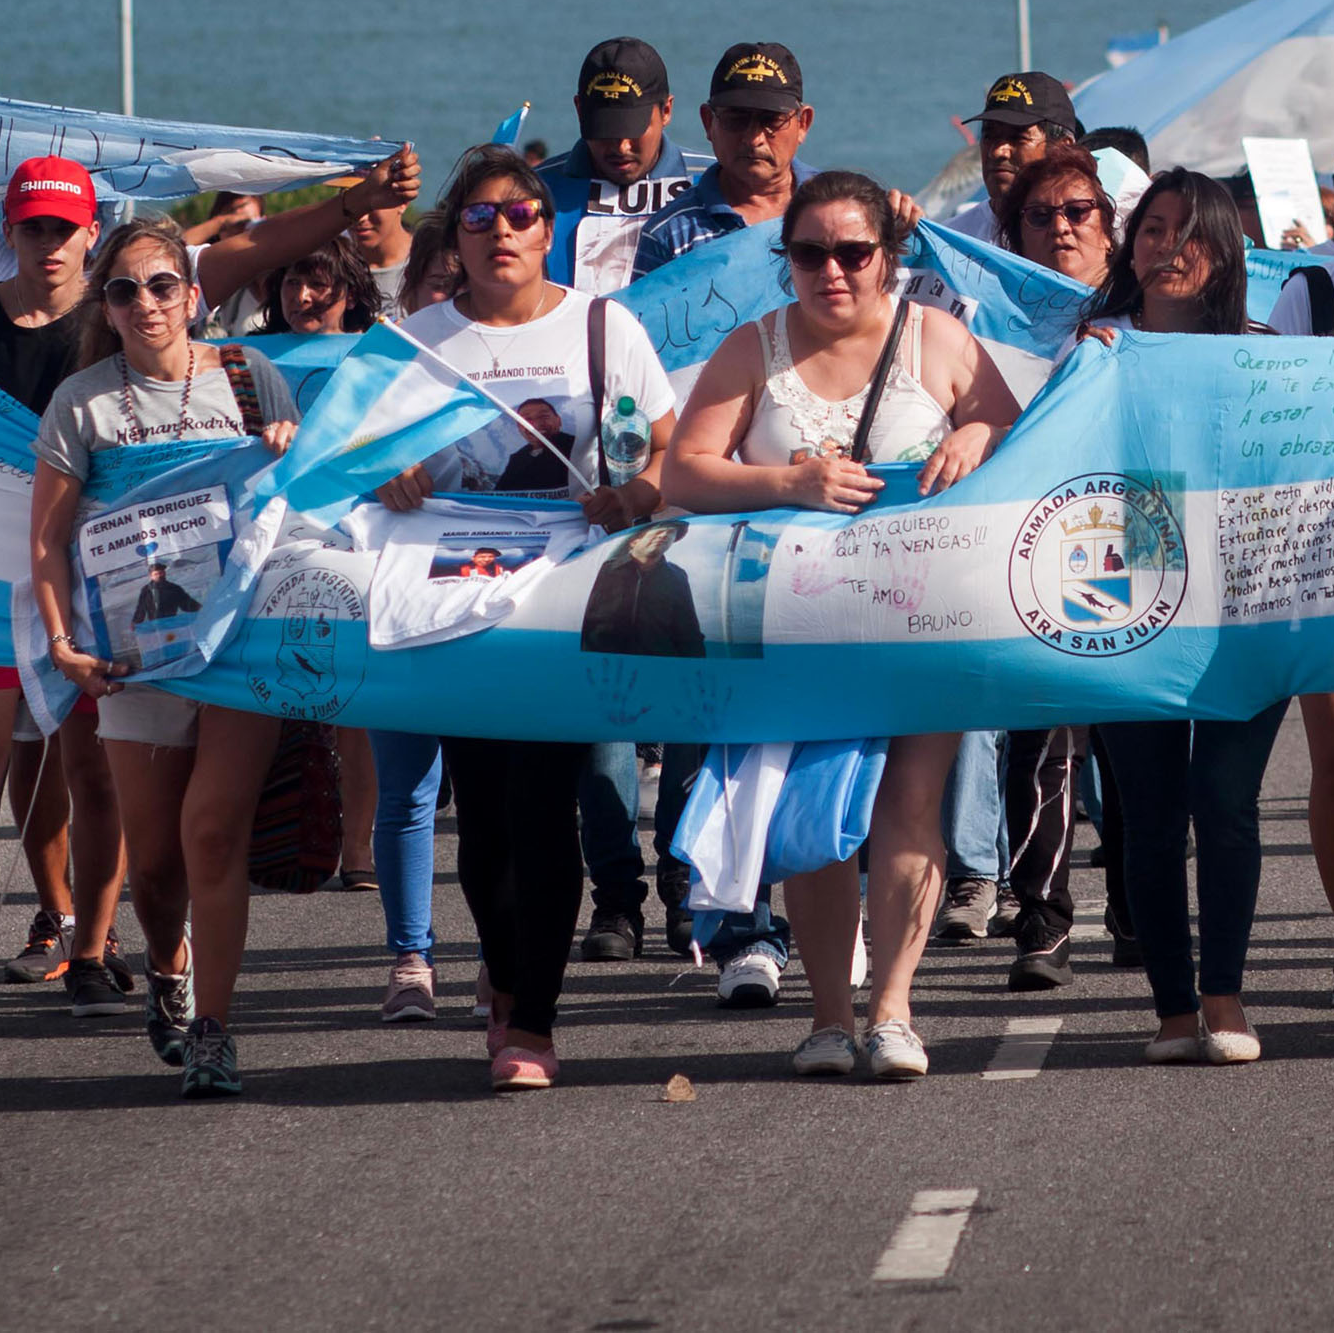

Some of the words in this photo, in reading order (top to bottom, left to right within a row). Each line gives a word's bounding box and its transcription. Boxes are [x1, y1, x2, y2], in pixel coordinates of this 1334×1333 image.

[19, 179, 82, 196] SHIMANO
[481, 367, 525, 381] ARMANDO
[180, 416, 244, 432] Rodrig
[85, 512, 134, 537] HERNAN
[137, 492, 213, 518] RODRIGUEZ
[1018, 488, 1078, 561] ARMADA
[1083, 480, 1179, 554] ARGENTINA
[89, 546, 105, 559] TE
[106, 526, 158, 556] AMAMOS
[160, 515, 207, 538] MUCHO
[887, 515, 951, 537] QUIERO
[835, 544, 863, 558] QUE
[871, 540, 892, 559] YA
[310, 569, 364, 622] ARGENTINA
[843, 579, 868, 595] TE
[1025, 608, 1064, 644] ARA
[1070, 635, 1117, 652] SAN
[1123, 598, 1173, 646] JUAN
